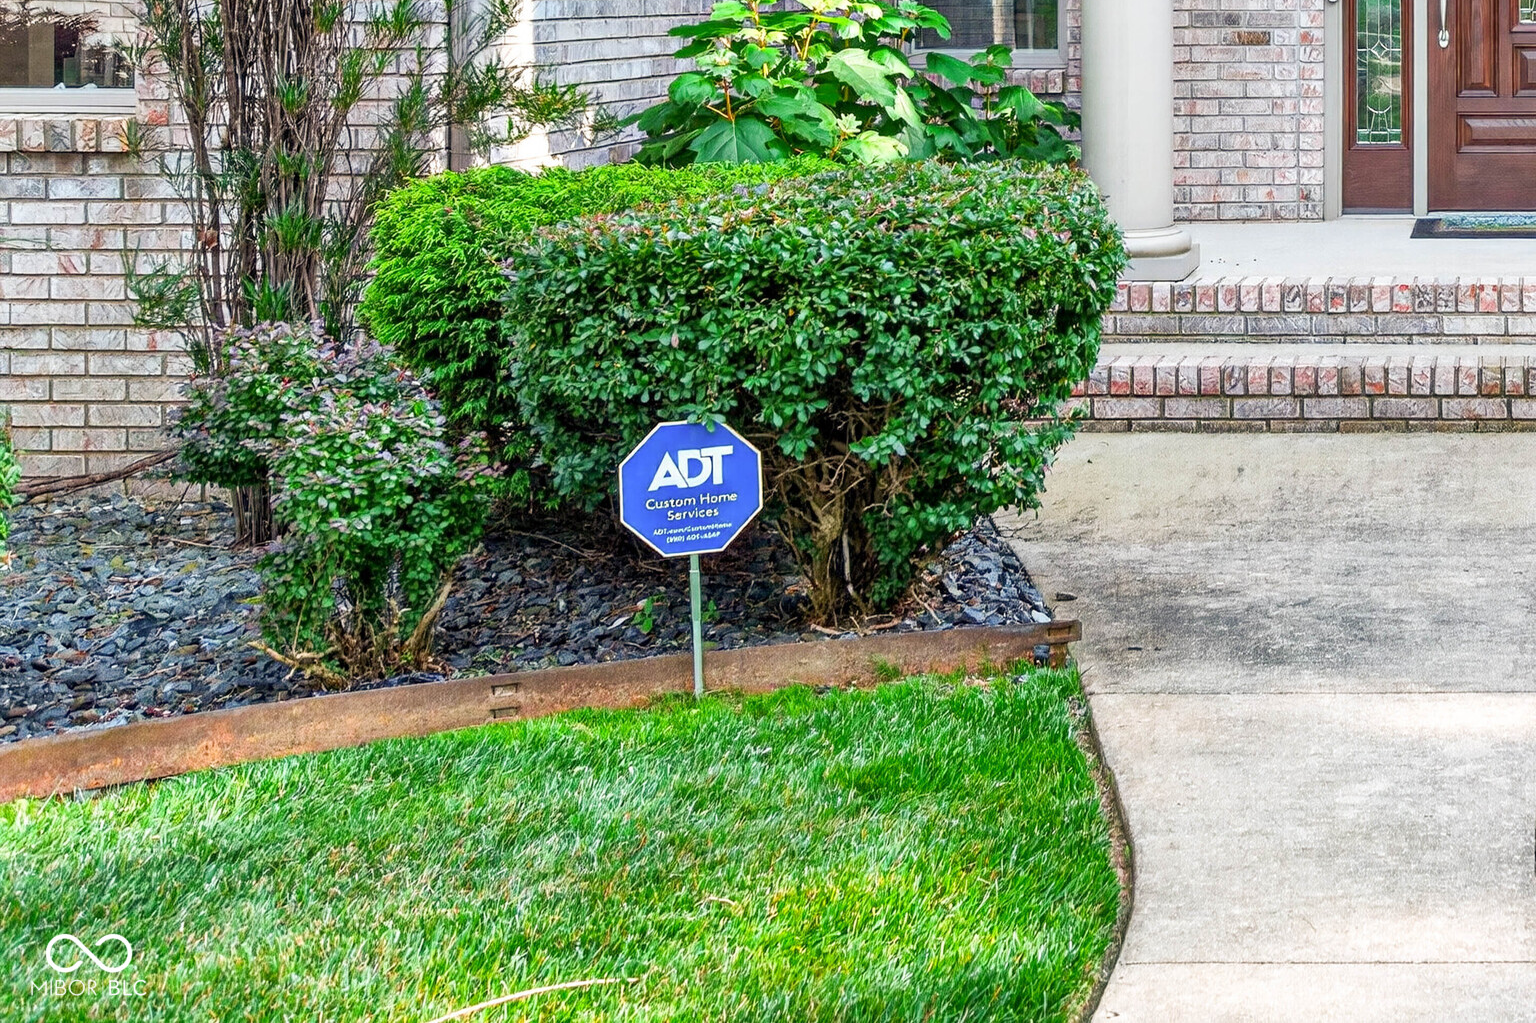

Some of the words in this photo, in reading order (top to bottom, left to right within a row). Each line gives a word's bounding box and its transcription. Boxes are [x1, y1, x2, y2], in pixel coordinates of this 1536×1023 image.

[647, 445, 733, 491] ADT
[645, 498, 696, 510] Custom
[699, 492, 738, 505] Home
[667, 507, 719, 521] Services
